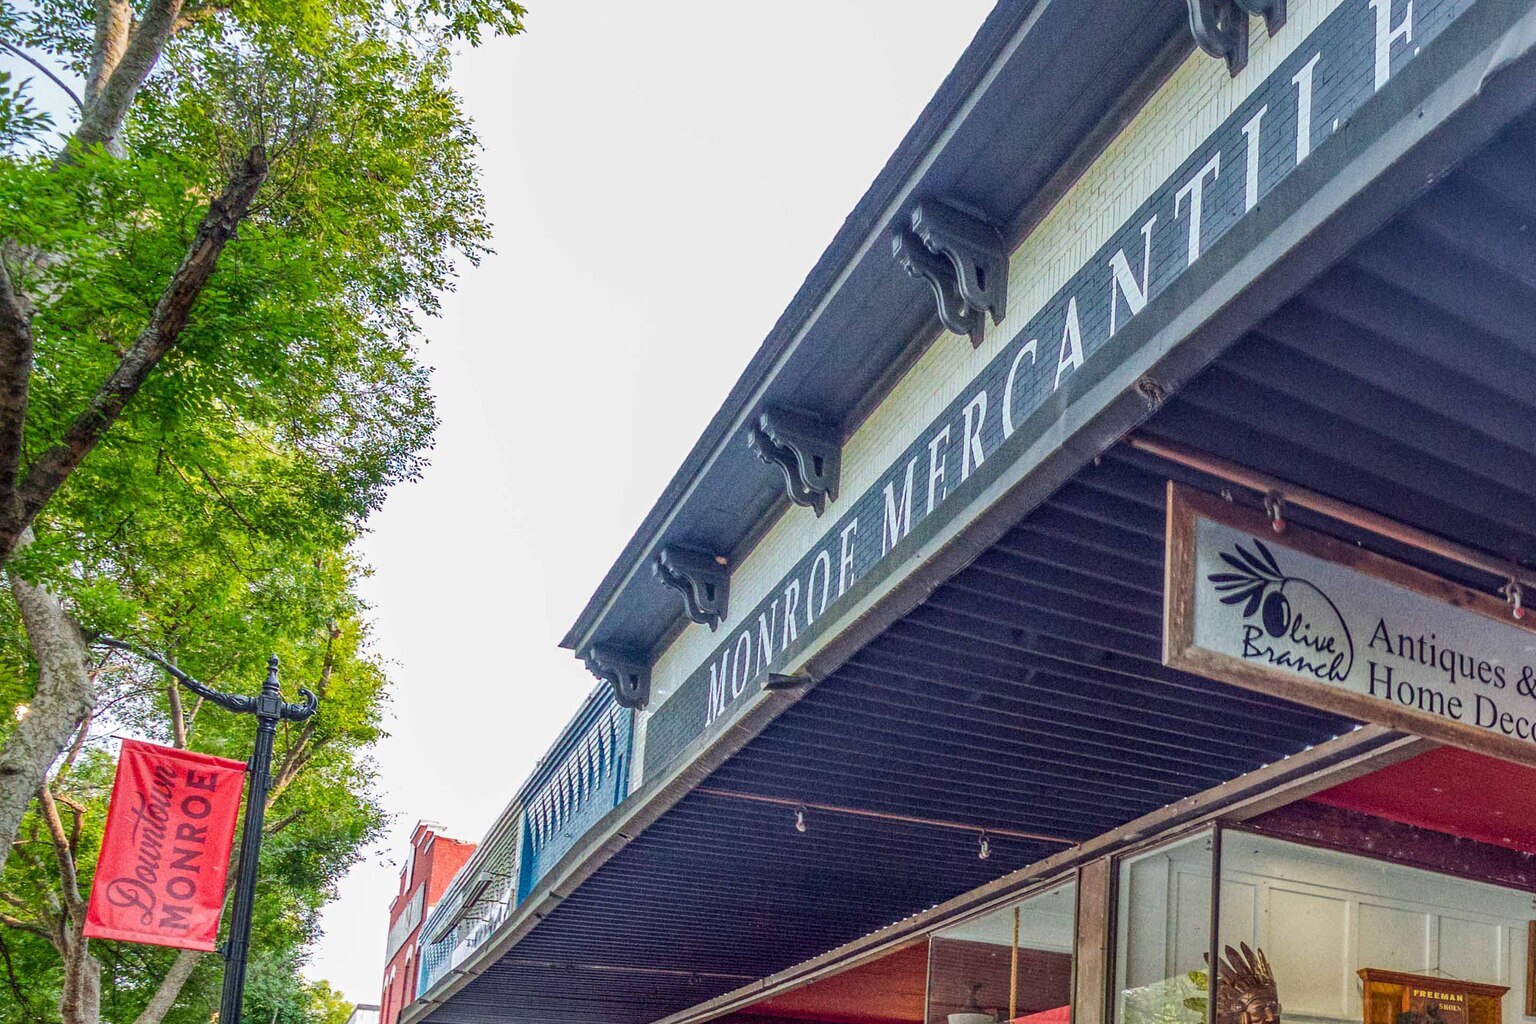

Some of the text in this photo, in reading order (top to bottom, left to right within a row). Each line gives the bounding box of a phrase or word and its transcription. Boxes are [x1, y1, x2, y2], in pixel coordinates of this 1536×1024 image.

[705, 0, 1420, 728] MONROE MERCANTILE
[1243, 625, 1349, 682] Branch
[1262, 591, 1336, 653] Olive
[1368, 617, 1506, 690] Antiques
[1367, 660, 1463, 720] Home
[106, 764, 178, 927] Downtown
[159, 769, 218, 930] MONROE
[1413, 989, 1463, 1002] FREEMAN
